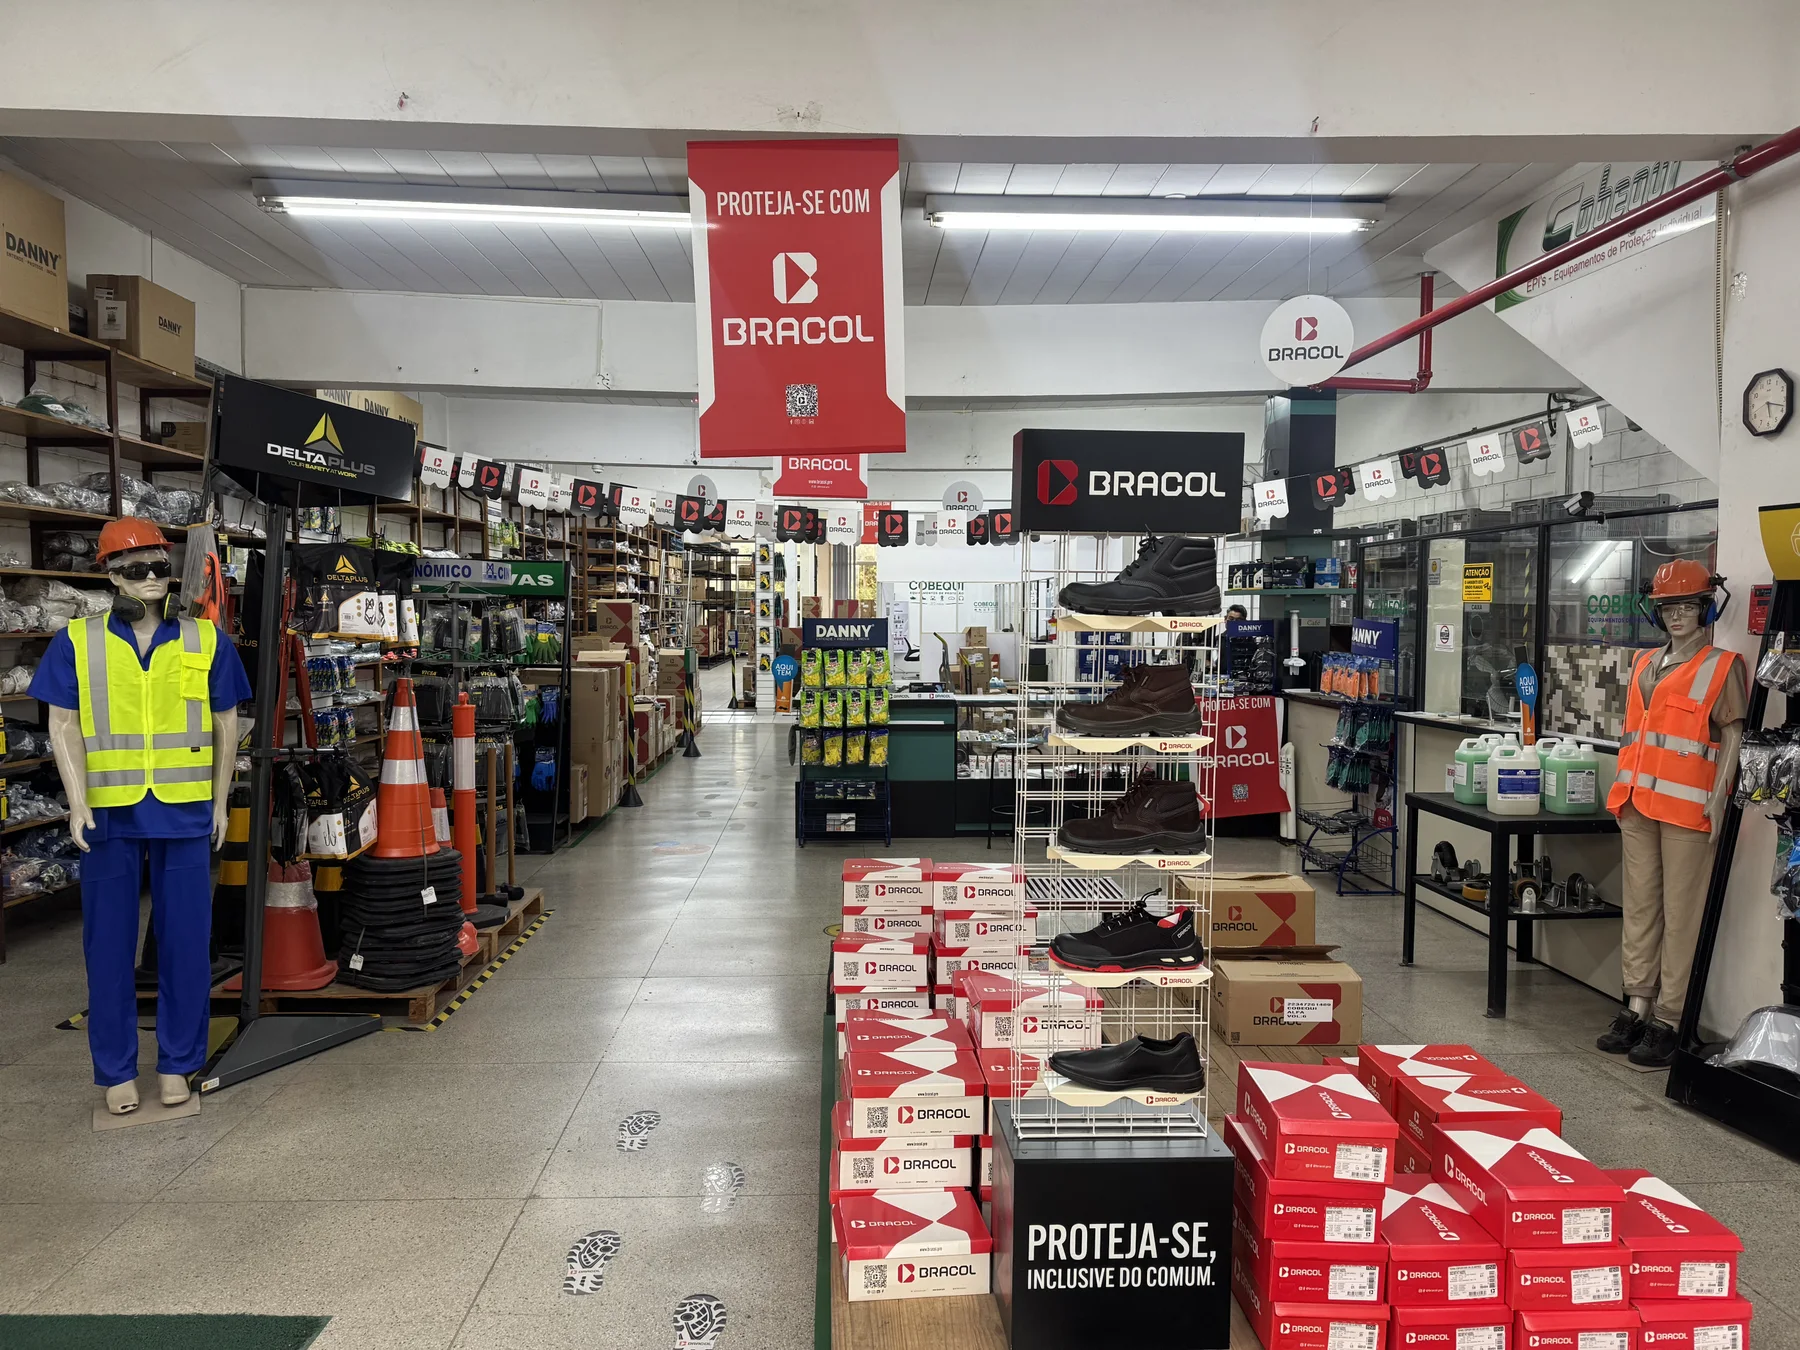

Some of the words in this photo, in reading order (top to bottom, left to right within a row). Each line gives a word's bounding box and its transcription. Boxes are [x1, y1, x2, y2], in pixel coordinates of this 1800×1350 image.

[716, 189, 826, 216] PROTEJA-SE
[829, 188, 871, 215] COM
[5, 231, 60, 270] DANNY
[1526, 274, 1547, 294] EPI's
[1553, 252, 1606, 282] Equipamentos
[1607, 245, 1618, 259] de
[1619, 229, 1657, 256] Proteção
[1658, 205, 1703, 235] Individual
[158, 315, 182, 335] DANNY
[722, 314, 875, 346] BRACOL
[1268, 345, 1344, 362] BRACOL
[1572, 424, 1600, 437] BRACOL
[788, 457, 853, 471] BRACOL
[1472, 453, 1501, 465] BRACOL
[287, 459, 305, 468] YOUR
[304, 463, 331, 474] SAFETY
[330, 467, 339, 475] AT
[337, 470, 358, 479] WORK
[424, 465, 449, 477] BRACOL
[1088, 470, 1226, 497] BRACOL
[1364, 478, 1393, 489] BRACOL
[521, 488, 547, 497] BRACOL
[1257, 498, 1286, 508] BRACOL
[622, 505, 647, 514] BRACOL
[1465, 567, 1490, 579] ATENÇÃO
[908, 580, 965, 591] COBEQUI
[815, 624, 872, 638] DANNY
[1238, 624, 1262, 632] DANNY
[775, 663, 794, 671] AQUI
[1519, 676, 1535, 687] AQUI
[1520, 686, 1535, 696] TEM
[1251, 697, 1271, 709] COM
[1202, 752, 1275, 769] BRACOL
[888, 886, 923, 894] BRACOL
[887, 920, 922, 928] BRACOL
[1212, 922, 1258, 932] BRACOL
[879, 964, 917, 972] BRACOL
[881, 1000, 919, 1009] BRACOL
[917, 1108, 971, 1119] BRACOL
[1297, 1145, 1330, 1154] BRACOL
[903, 1159, 957, 1170] BRACOL
[1525, 1150, 1561, 1175] BRACOL
[1455, 1166, 1488, 1206] BRACOL
[1285, 1206, 1318, 1214] BRACOL
[1639, 1198, 1675, 1225] BRACOL
[1419, 1205, 1448, 1232] BRACOL
[1523, 1213, 1556, 1221] BRACOL
[1027, 1221, 1217, 1264] PROTEJA-SE,
[919, 1264, 976, 1278] BRACOL
[1290, 1268, 1322, 1276] BRACOL
[1641, 1265, 1674, 1273] BRACOL
[1027, 1267, 1115, 1290] INCLUSIVE
[1119, 1266, 1142, 1288] DO
[1146, 1265, 1216, 1288] COMUM.
[1409, 1271, 1442, 1279] BRACOL
[1532, 1276, 1566, 1284] BRACOL
[1291, 1325, 1324, 1333] BRACOL
[1417, 1333, 1450, 1341] BRACOL
[1540, 1337, 1574, 1345] BRACOL
[1656, 1332, 1688, 1341] BRACOL
